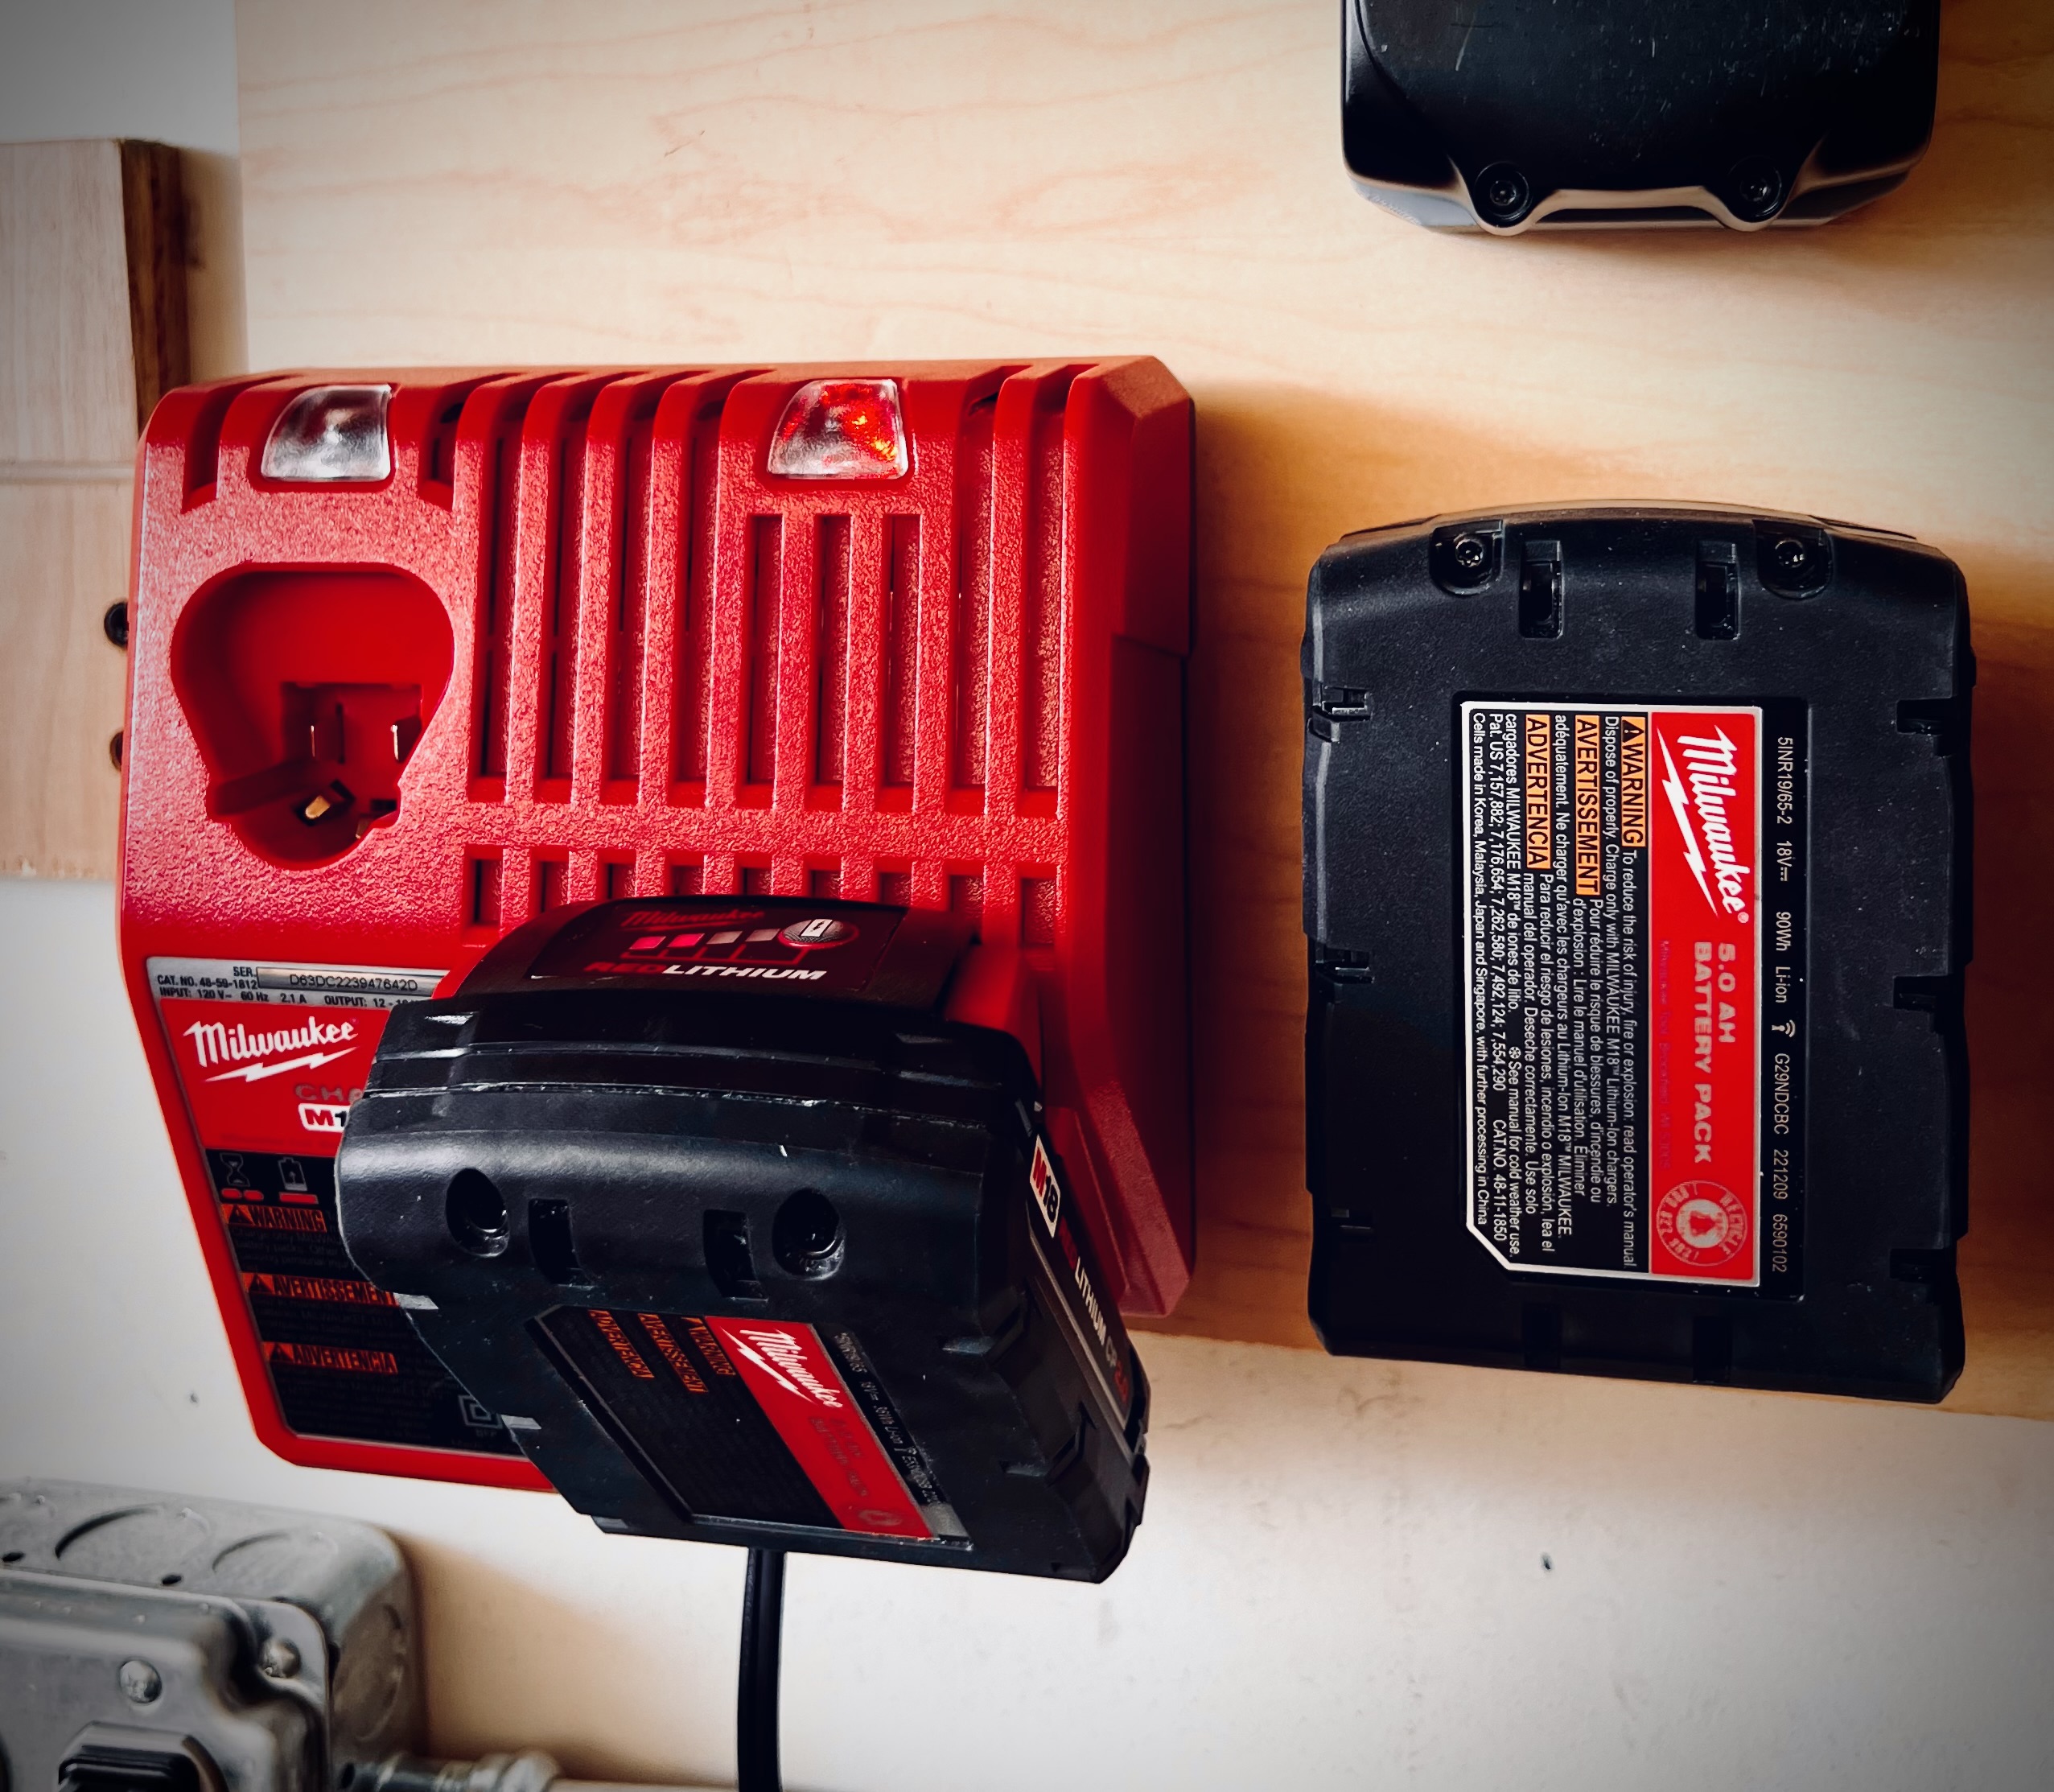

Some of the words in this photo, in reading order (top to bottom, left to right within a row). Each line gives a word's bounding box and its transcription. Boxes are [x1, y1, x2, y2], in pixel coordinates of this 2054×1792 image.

[1474, 713, 1488, 744] Cells
[1489, 713, 1503, 739] Pat.
[1602, 716, 1619, 768] Dispose
[1474, 745, 1488, 782] made
[1490, 742, 1504, 760] US
[1502, 713, 1519, 784] cargadores
[1552, 715, 1569, 808] adéquatement.
[1474, 784, 1488, 795] in
[1488, 763, 1504, 827] 7,157,882;
[1526, 717, 1548, 866] ADVERTENCIA
[1606, 771, 1620, 784] of
[1622, 743, 1644, 845] WARNING
[1776, 736, 1793, 822] 5INR19/65-2
[1472, 797, 1488, 837] Korea,
[1556, 813, 1570, 830] Ne
[1576, 718, 1599, 893] AVERTISSEMENT
[1602, 787, 1620, 840] properly.
[1677, 724, 1750, 914] Milwaukee
[1506, 787, 1520, 869] MILWAUKEE
[1472, 840, 1488, 898] Malaysia,
[1488, 830, 1504, 895] 7,176,654;
[1553, 834, 1570, 882] charger
[1603, 843, 1620, 890] Charge
[1623, 850, 1636, 864] To
[1523, 872, 1537, 919] manual
[1540, 874, 1554, 903] Para
[1603, 893, 1620, 921] only
[1623, 867, 1636, 911] reduce
[1472, 900, 1489, 938] Japan
[1507, 912, 1521, 929] de
[1540, 906, 1554, 951] reducir
[1553, 885, 1570, 933] qu'avec
[1590, 900, 1603, 929] Pour
[1623, 916, 1636, 935] the
[1489, 898, 1505, 961] 7,262,580;
[1508, 932, 1521, 966] iones
[1524, 922, 1537, 941] del
[1557, 937, 1570, 954] les
[1570, 898, 1587, 967] d'explosion
[1606, 922, 1620, 948] with
[1623, 938, 1636, 961] risk
[1775, 912, 1791, 951] 90Wh
[233, 966, 257, 978] SER.
[583, 962, 827, 980] REDLITHIUM
[1476, 941, 1489, 966] and
[1541, 953, 1554, 964] el
[1590, 932, 1603, 975] réduire
[1624, 964, 1637, 977] of
[1717, 941, 1735, 994] 5.0
[157, 974, 179, 986] CAT.
[180, 976, 198, 987] NO.
[200, 977, 257, 991] 48-59-1812
[1508, 969, 1521, 985] de
[1521, 945, 1537, 1003] operador.
[1537, 967, 1554, 1006] riesgo
[1554, 958, 1570, 1020] chargeurs
[1574, 978, 1587, 1003] Lire
[1590, 978, 1603, 991] le
[1607, 953, 1620, 1033] MILWAUKEE
[1774, 966, 1790, 1004] Li-ion
[160, 987, 191, 999] INPUT:
[197, 988, 216, 999] 120
[240, 991, 254, 1001] 60
[256, 991, 270, 1003] Hz
[280, 992, 296, 1004] 2.1
[298, 994, 307, 1004] A
[324, 995, 368, 1007] OUTPUT:
[373, 997, 385, 1008] 12
[1472, 967, 1490, 1033] Singapore,
[1490, 964, 1505, 1027] 7,492,124;
[1508, 988, 1521, 1012] litio.
[1574, 1006, 1587, 1017] le
[1587, 995, 1603, 1032] risque
[1620, 980, 1637, 1015] injury,
[1693, 941, 1712, 1074] BATTERY
[1525, 1007, 1538, 1062] Deseche
[1541, 1009, 1554, 1025] de
[1557, 1024, 1567, 1040] au
[1624, 1020, 1637, 1040] fire
[1717, 1001, 1736, 1043] AH
[183, 1016, 359, 1067] Milwaukee
[1476, 1036, 1490, 1062] with
[1491, 1032, 1506, 1091] 7,554,290
[1539, 1028, 1554, 1083] lesiones,
[1574, 1020, 1587, 1065] manuel
[1591, 1035, 1604, 1051] de
[1624, 1043, 1634, 1056] or
[1477, 1064, 1491, 1104] further
[1509, 1061, 1522, 1085] See
[1558, 1043, 1571, 1110] Lithium-Ion
[1588, 1056, 1604, 1117] blessures,
[1509, 1088, 1522, 1133] manual
[1525, 1065, 1539, 1156] correctamente.
[1542, 1086, 1555, 1138] incendio
[1607, 1078, 1620, 1146] Lithium-Ion
[1773, 1053, 1790, 1135] G29NDCBC
[1474, 1106, 1491, 1173] processing
[1624, 1125, 1637, 1152] read
[1693, 1083, 1712, 1164] PACK
[1509, 1136, 1523, 1152] for
[1591, 1122, 1604, 1183] d'incendie
[1032, 1146, 1060, 1224] M18
[1478, 1176, 1492, 1188] in
[1509, 1154, 1523, 1180] cold
[1525, 1160, 1539, 1184] Use
[1538, 1154, 1555, 1215] explosión,
[1574, 1146, 1591, 1196] Éliminer
[1603, 1151, 1621, 1207] chargers.
[1620, 1157, 1637, 1217] operator's
[1772, 1148, 1789, 1200] 221209
[1478, 1189, 1492, 1225] China
[1493, 1175, 1508, 1241] 48-11-1850
[1509, 1181, 1523, 1231] weather
[1526, 1188, 1540, 1215] solo
[1558, 1154, 1572, 1238] MILWAUKEE.
[1591, 1188, 1602, 1202] ou
[249, 1205, 326, 1232] WARNING
[1542, 1218, 1556, 1238] lea
[1510, 1233, 1521, 1257] use.
[1542, 1241, 1556, 1252] el
[1772, 1213, 1788, 1272] 6590102
[294, 1344, 395, 1373] ADVERTENCIA
[739, 1328, 843, 1408] Milwaukee
